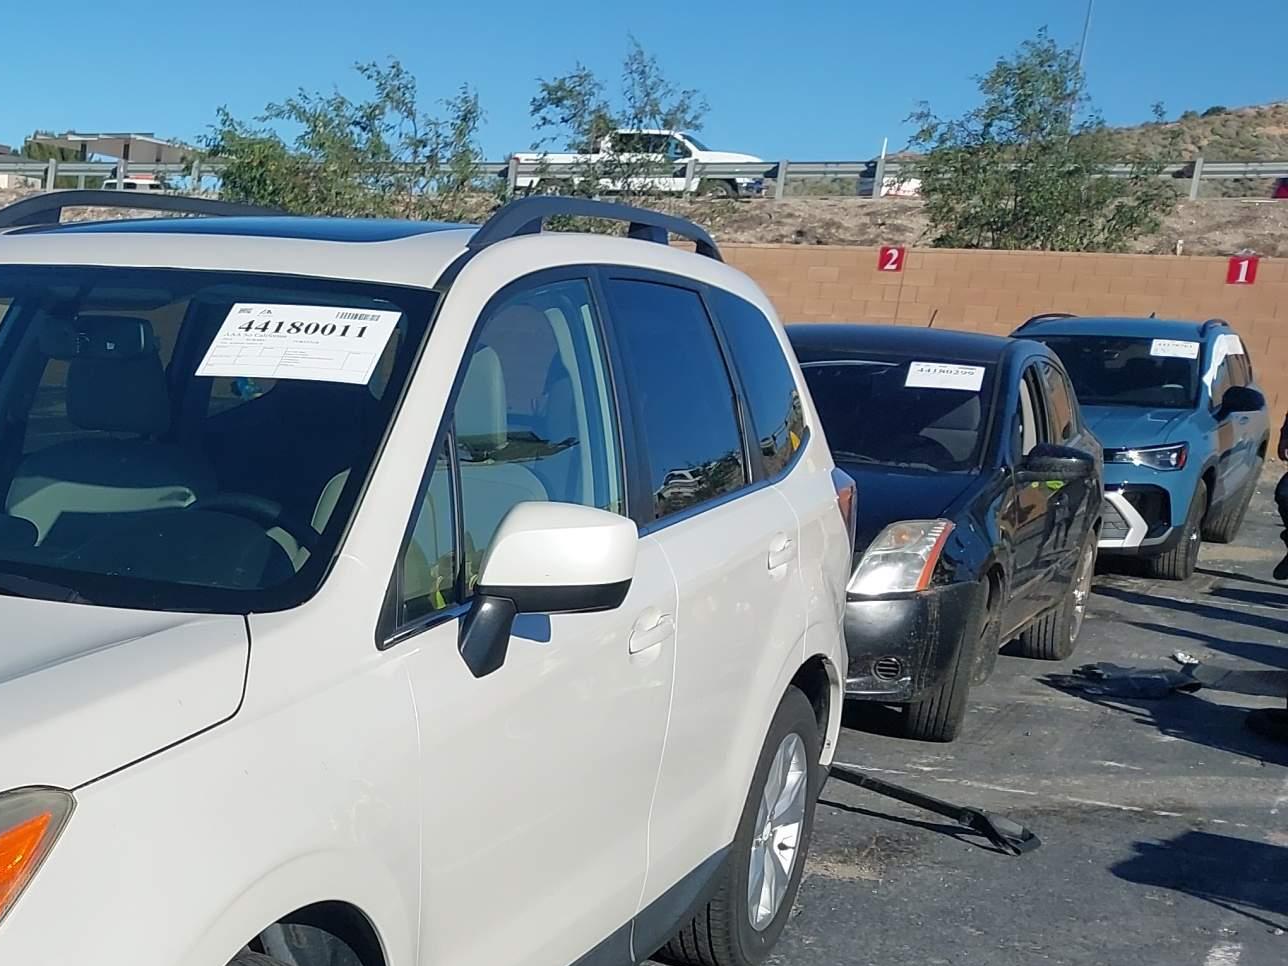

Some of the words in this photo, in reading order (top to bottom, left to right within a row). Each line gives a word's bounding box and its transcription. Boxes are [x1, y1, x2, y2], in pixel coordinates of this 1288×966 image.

[883, 249, 899, 270] 2
[1236, 260, 1249, 282] 1
[238, 319, 368, 338] 44180011
